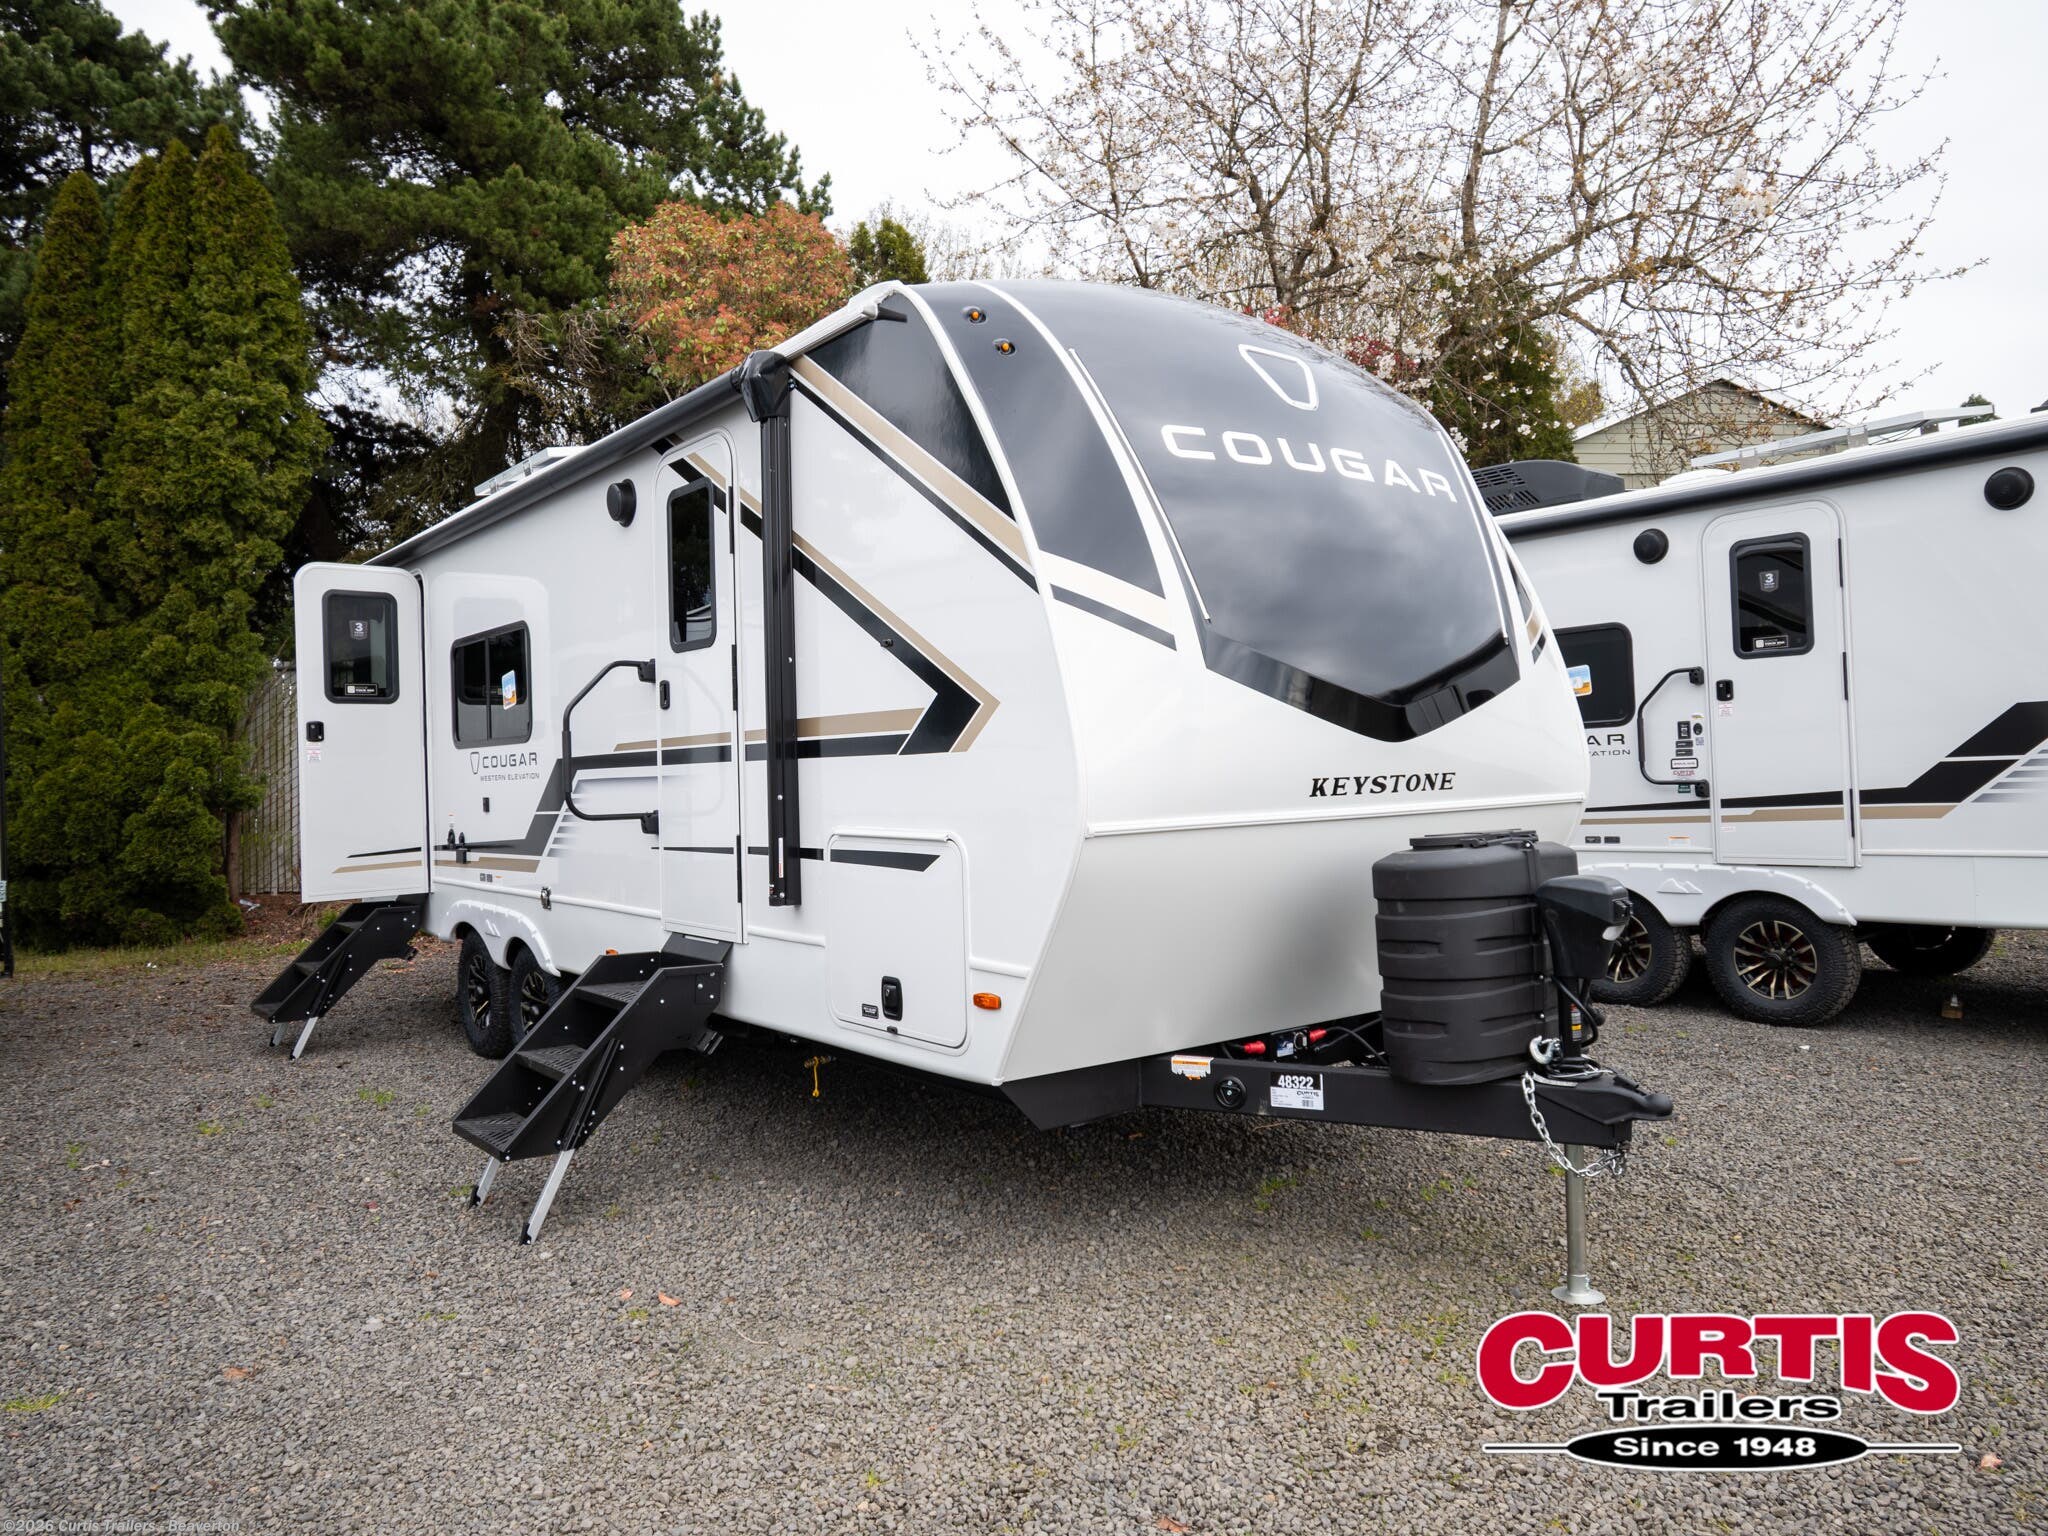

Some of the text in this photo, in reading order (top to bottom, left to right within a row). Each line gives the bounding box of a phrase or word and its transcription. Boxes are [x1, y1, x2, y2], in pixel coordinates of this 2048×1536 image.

[1161, 424, 1457, 503] COUGAR
[1765, 573, 1774, 583] 3
[355, 622, 364, 632] 3
[482, 752, 537, 768] COUGAR
[480, 772, 540, 782] WESTERN ELEVATION
[1309, 772, 1456, 798] KEYSTONE
[1278, 1074, 1314, 1090] 48322
